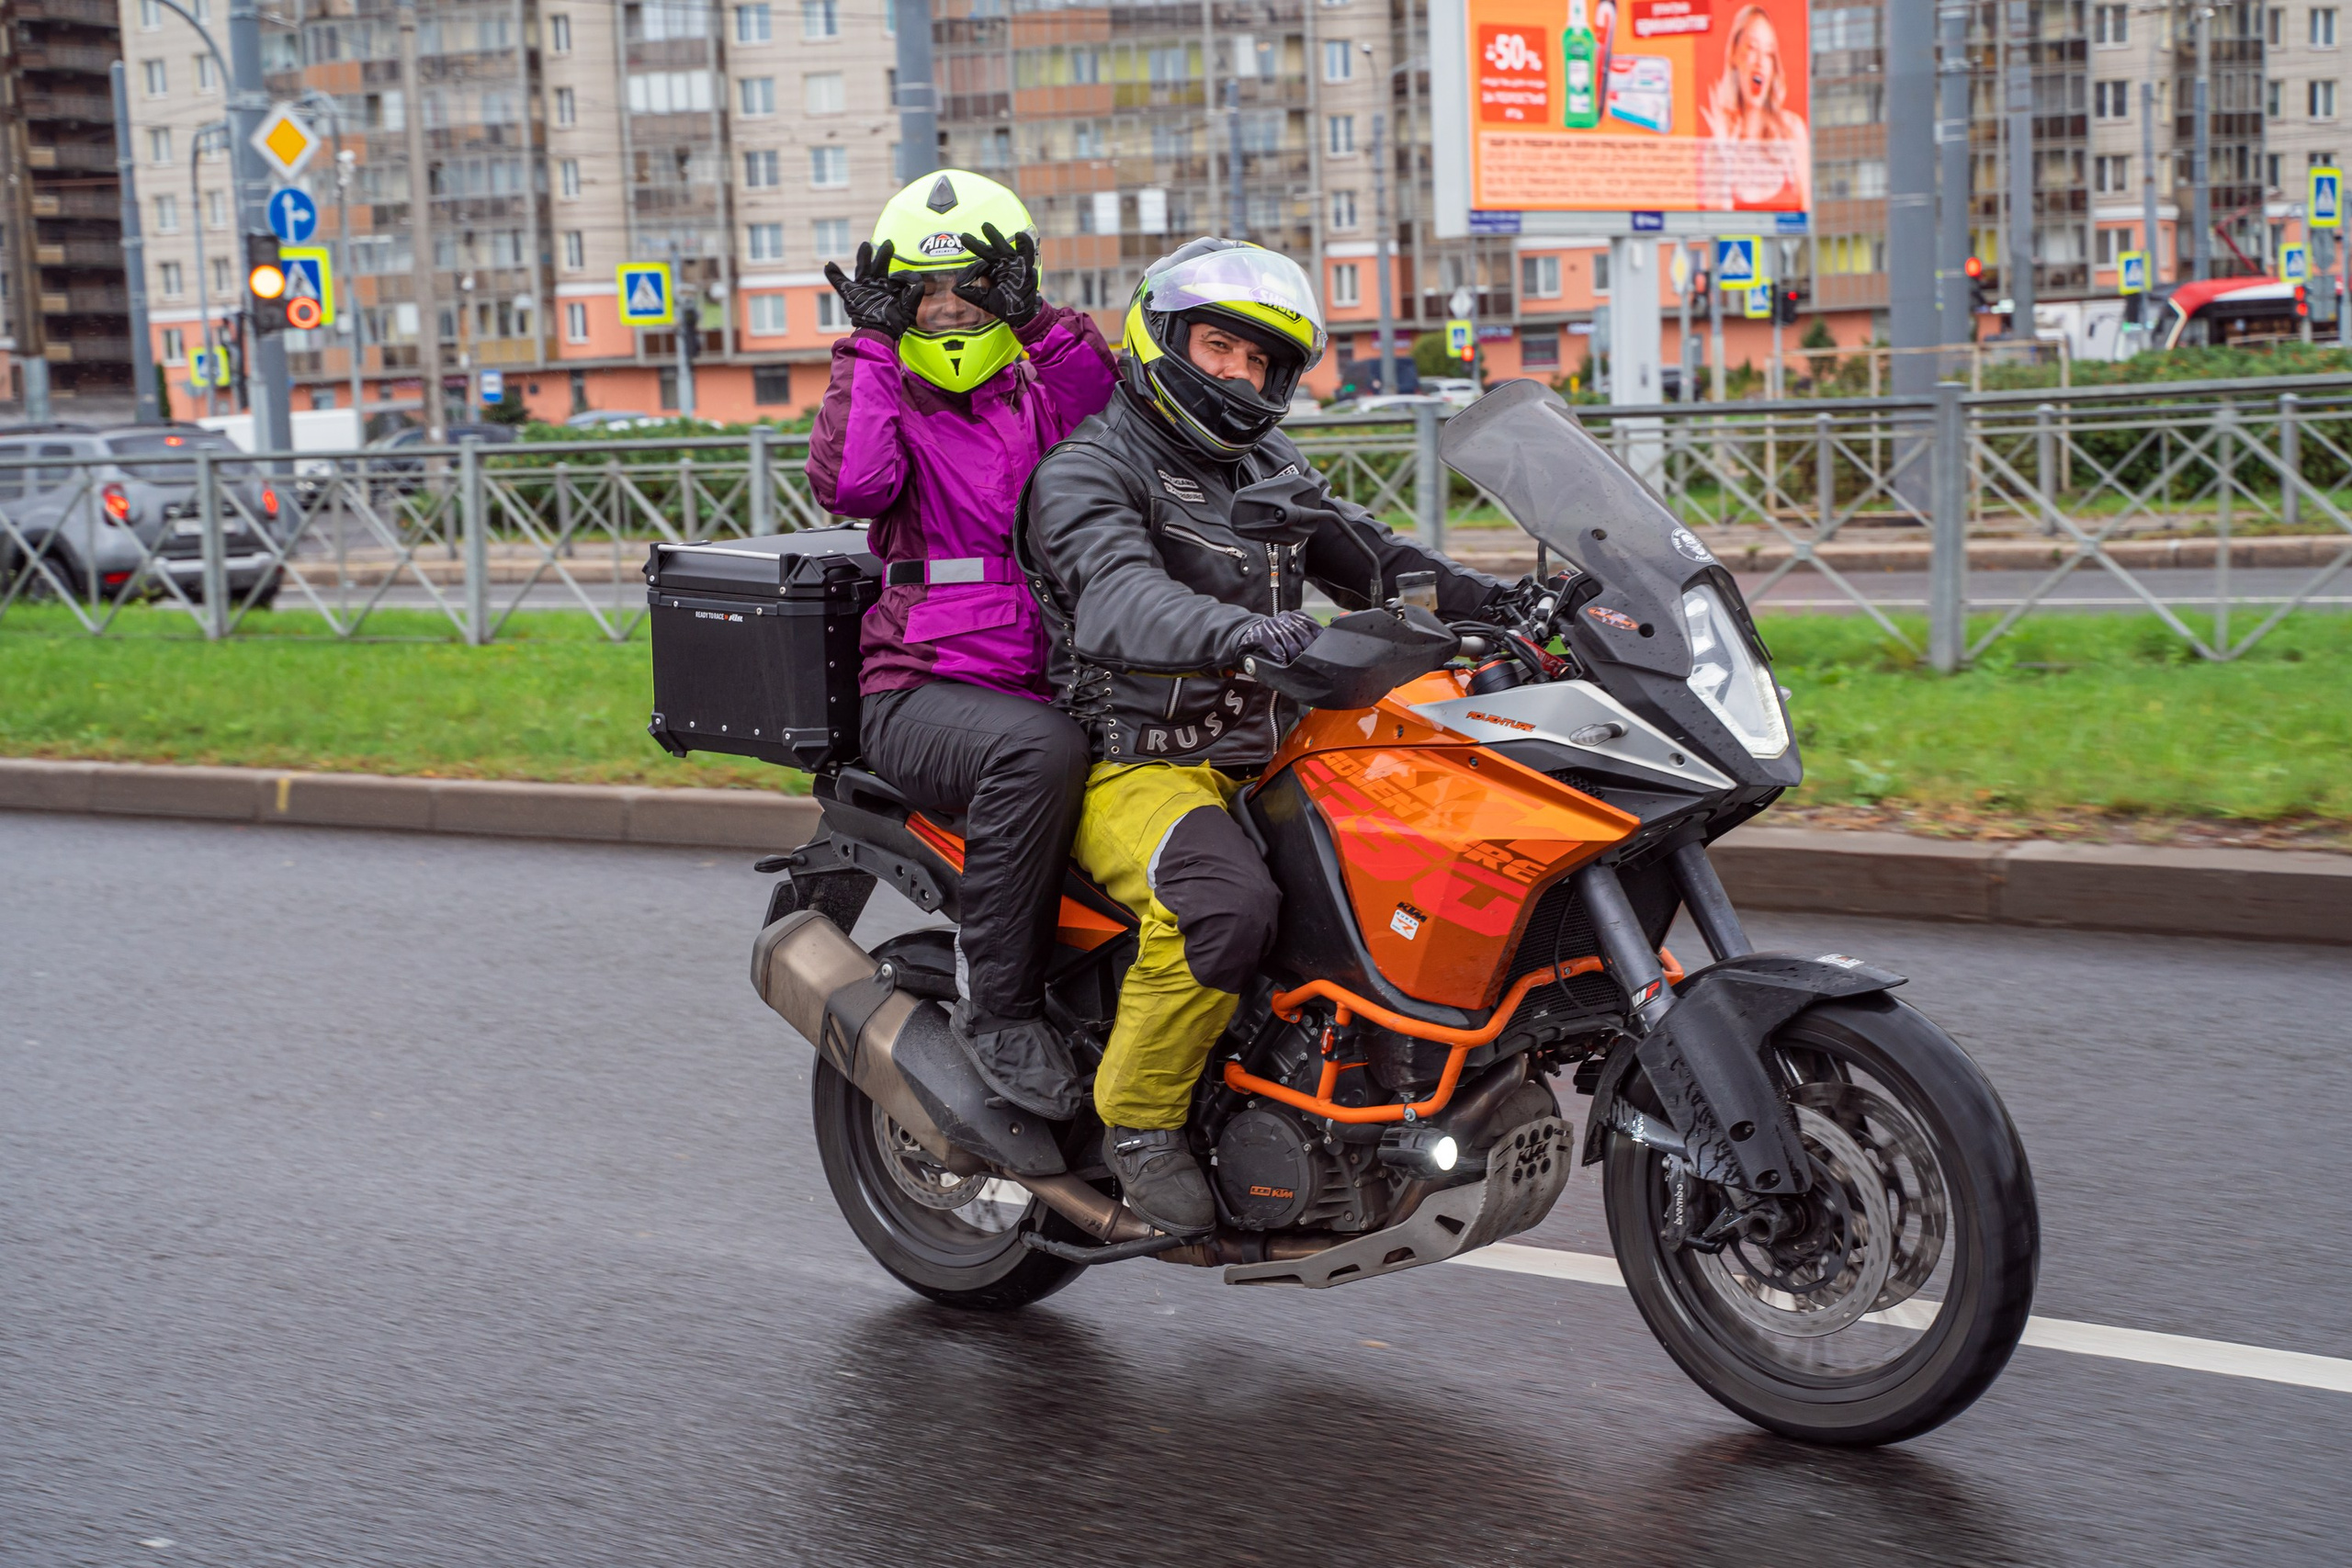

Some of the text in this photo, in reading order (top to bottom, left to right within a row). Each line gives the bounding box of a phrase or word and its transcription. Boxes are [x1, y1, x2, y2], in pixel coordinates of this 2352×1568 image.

[1465, 711, 1536, 732] ADVENTURE
[1396, 902, 1428, 922] KTM
[1632, 981, 1660, 1008] WP
[1272, 1189, 1294, 1199] KTM
[1674, 1183, 1684, 1225] brembo
